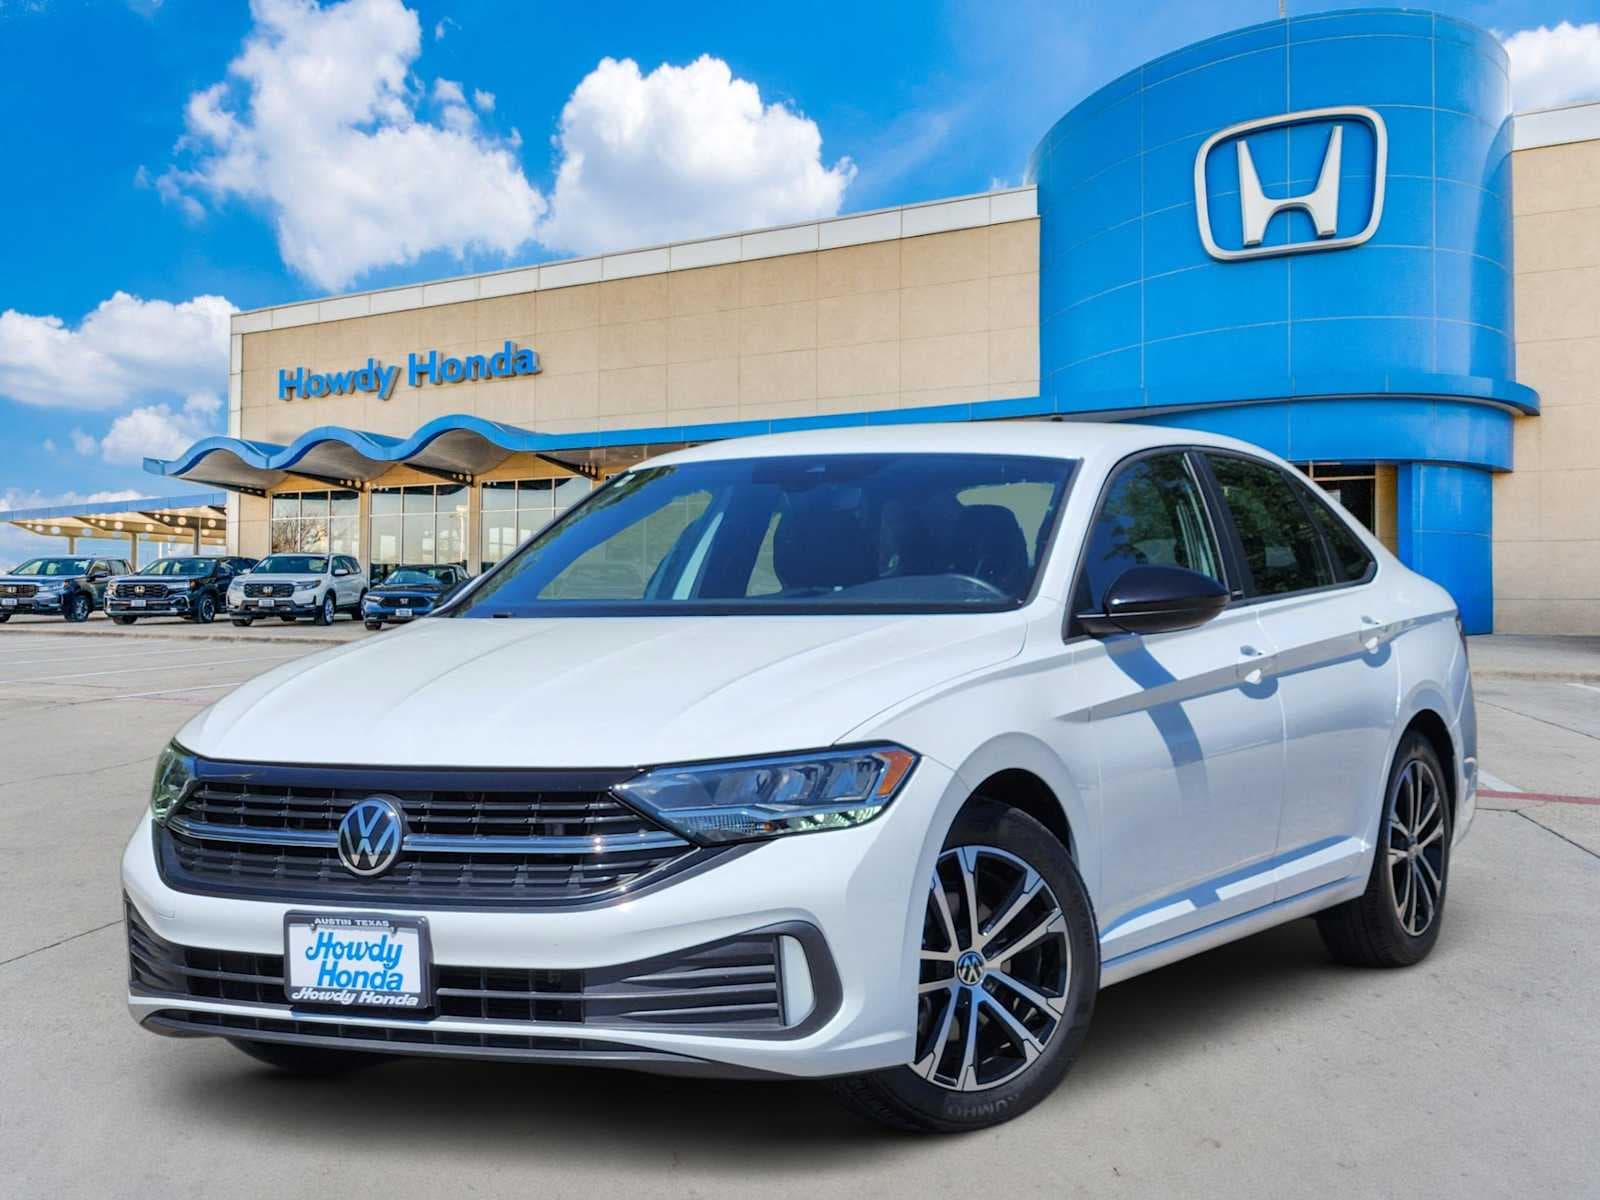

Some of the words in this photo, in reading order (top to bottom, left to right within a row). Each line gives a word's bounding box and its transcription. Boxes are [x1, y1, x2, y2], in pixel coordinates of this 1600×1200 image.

[278, 357, 401, 401] Howdy
[408, 340, 542, 387] Honda
[314, 917, 352, 926] AUSTIN
[354, 919, 390, 927] TEXAS
[305, 931, 403, 970] Howdy
[317, 960, 403, 991] Honda
[292, 987, 356, 1005] Howdy
[358, 991, 419, 1006] Honda
